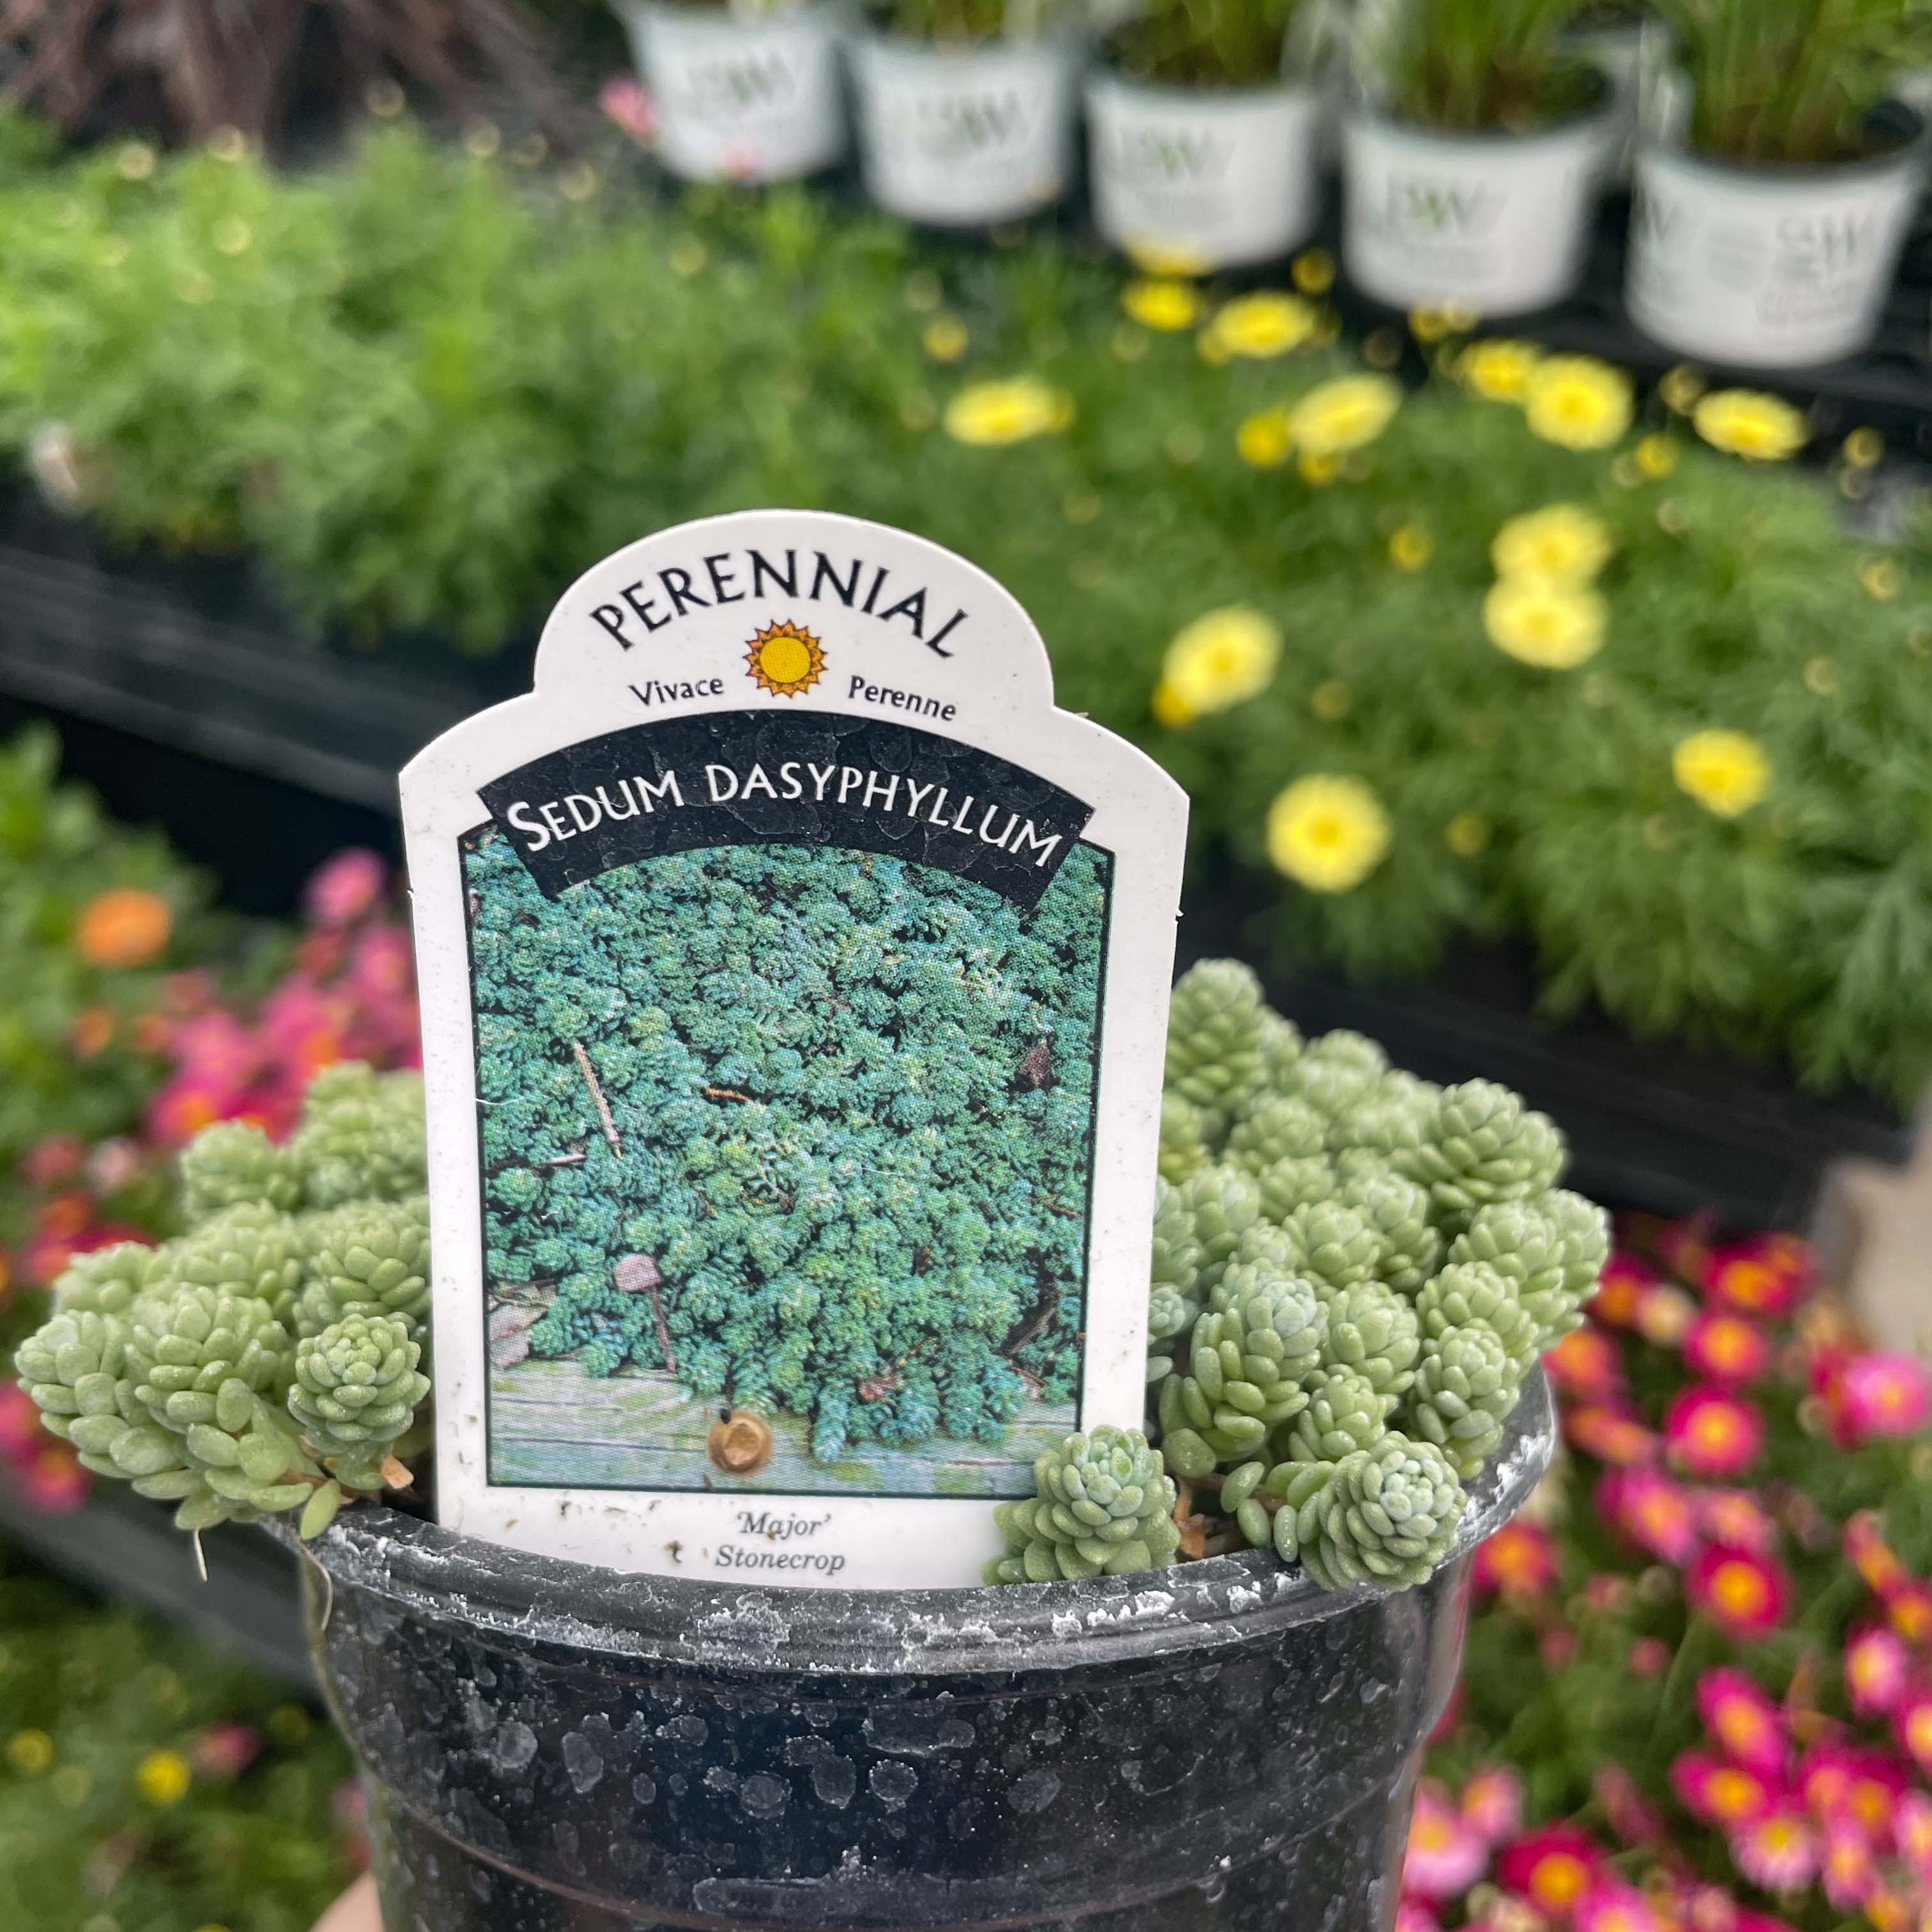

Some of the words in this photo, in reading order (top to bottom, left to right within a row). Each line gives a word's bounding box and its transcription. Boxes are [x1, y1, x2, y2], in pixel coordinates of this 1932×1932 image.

[590, 548, 969, 659] PERENNIAL
[629, 677, 724, 706] Vivace
[848, 675, 957, 721] Perenne
[507, 770, 685, 852] SEDUM
[705, 762, 1063, 866] DASYPHYLLUM
[737, 1511, 831, 1540] 'Major'
[715, 1544, 846, 1575] Stonecrop
